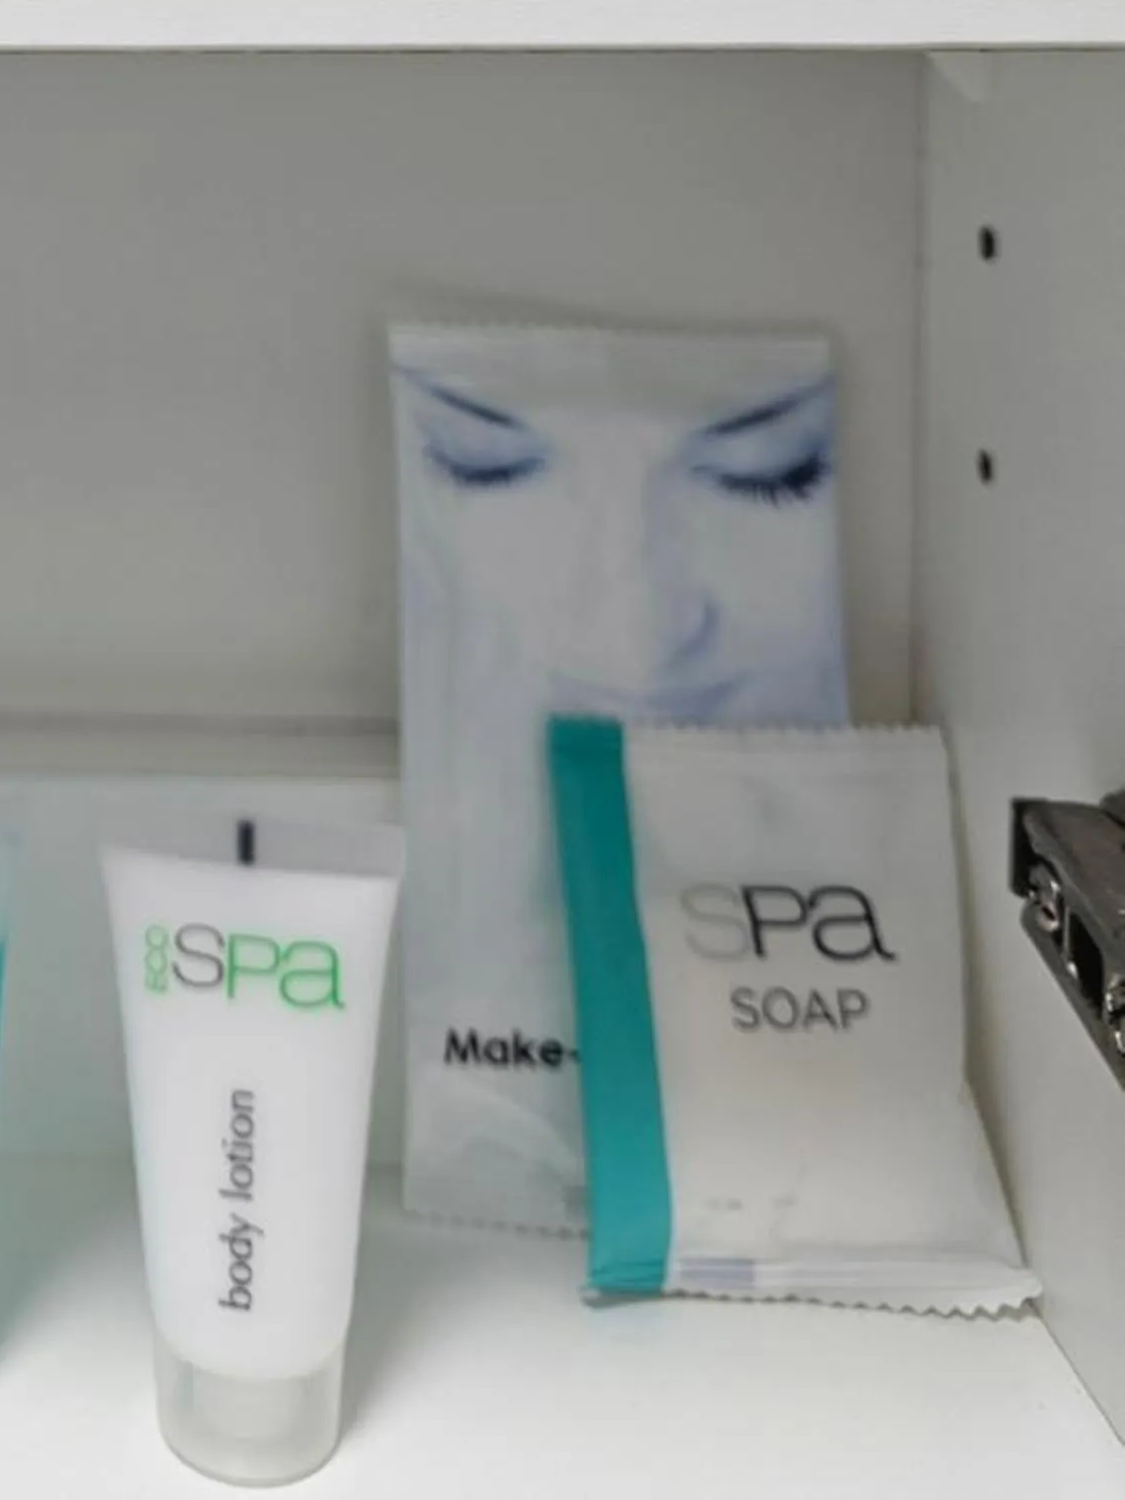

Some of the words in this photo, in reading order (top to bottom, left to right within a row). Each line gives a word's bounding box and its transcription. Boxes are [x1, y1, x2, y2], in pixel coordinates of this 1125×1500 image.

[729, 986, 871, 1033] SOAP
[219, 1089, 254, 1202] lotion
[219, 1213, 264, 1311] body
